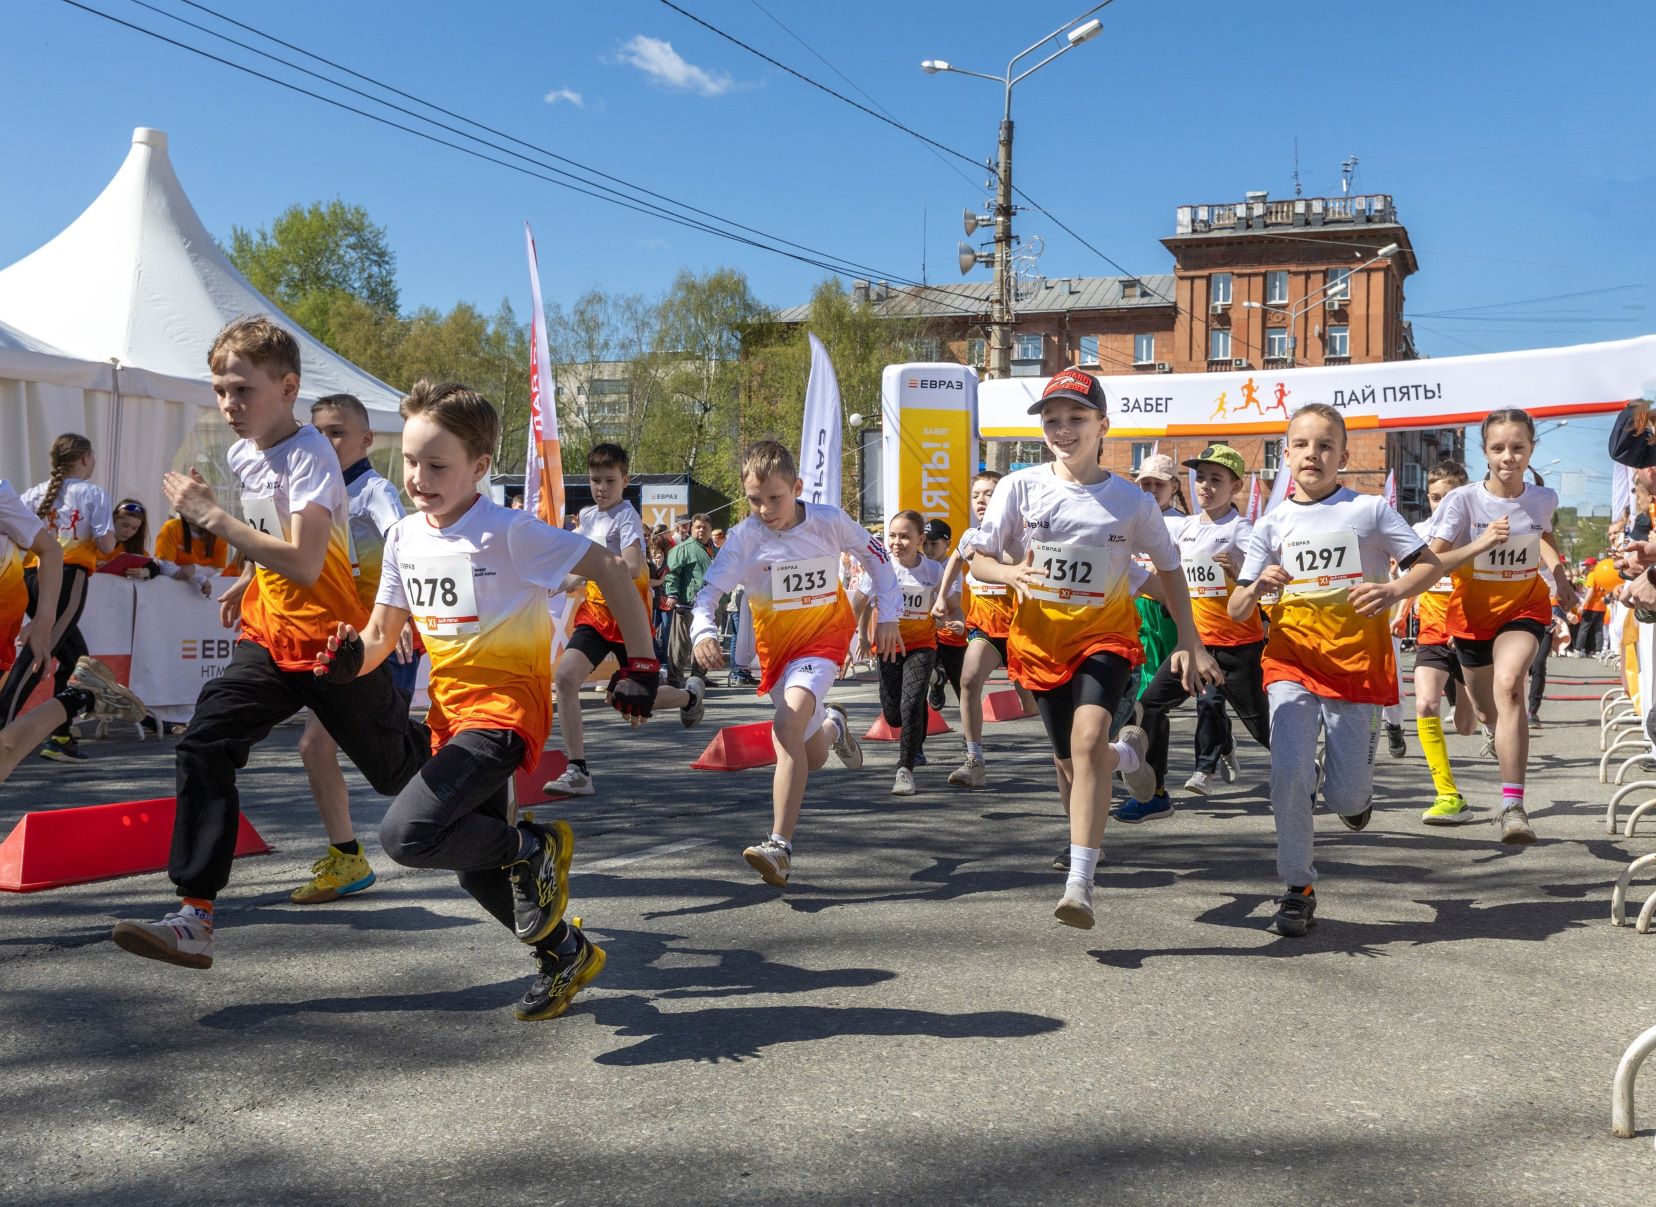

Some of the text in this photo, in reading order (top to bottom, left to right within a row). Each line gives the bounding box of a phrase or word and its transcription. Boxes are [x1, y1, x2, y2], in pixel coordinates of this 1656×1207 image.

[920, 379, 964, 390] ЕВРАЗ
[1120, 383, 1442, 413] ЗАБЕГ ДАЙ ПЯТЬ!
[1041, 545, 1062, 553] ЕВРАЗ
[1489, 548, 1527, 565] 1114
[1295, 546, 1347, 572] 1297
[1043, 558, 1093, 584] 1312
[1186, 565, 1215, 582] 1186
[783, 569, 827, 593] 1233
[1320, 577, 1328, 585] XI
[407, 577, 458, 607] 1278
[1061, 588, 1070, 598] XI
[428, 618, 437, 628] XI
[1367, 745, 1375, 765] MAKE
